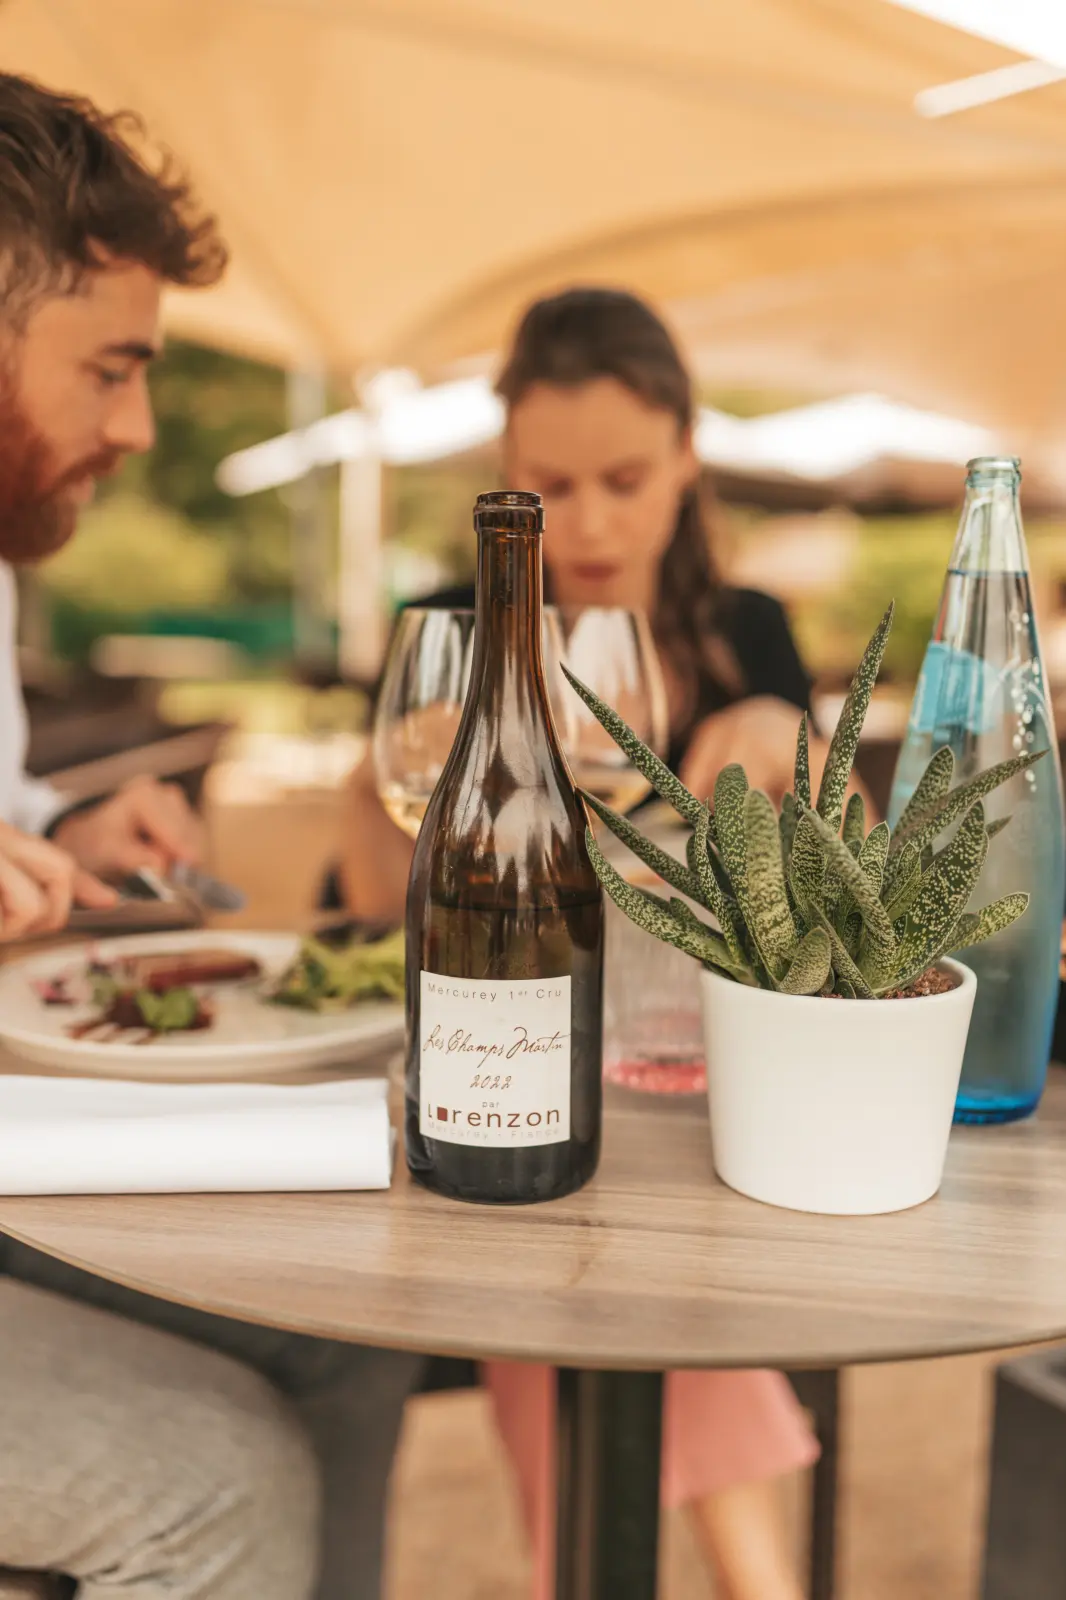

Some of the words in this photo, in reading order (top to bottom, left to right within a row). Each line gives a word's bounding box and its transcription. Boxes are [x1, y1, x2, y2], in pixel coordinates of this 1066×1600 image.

[428, 983, 497, 1002] Mercurey
[536, 989, 562, 999] Cru
[446, 1029, 504, 1068] Champs
[506, 1027, 571, 1059] Martin
[470, 1075, 512, 1089] 2022
